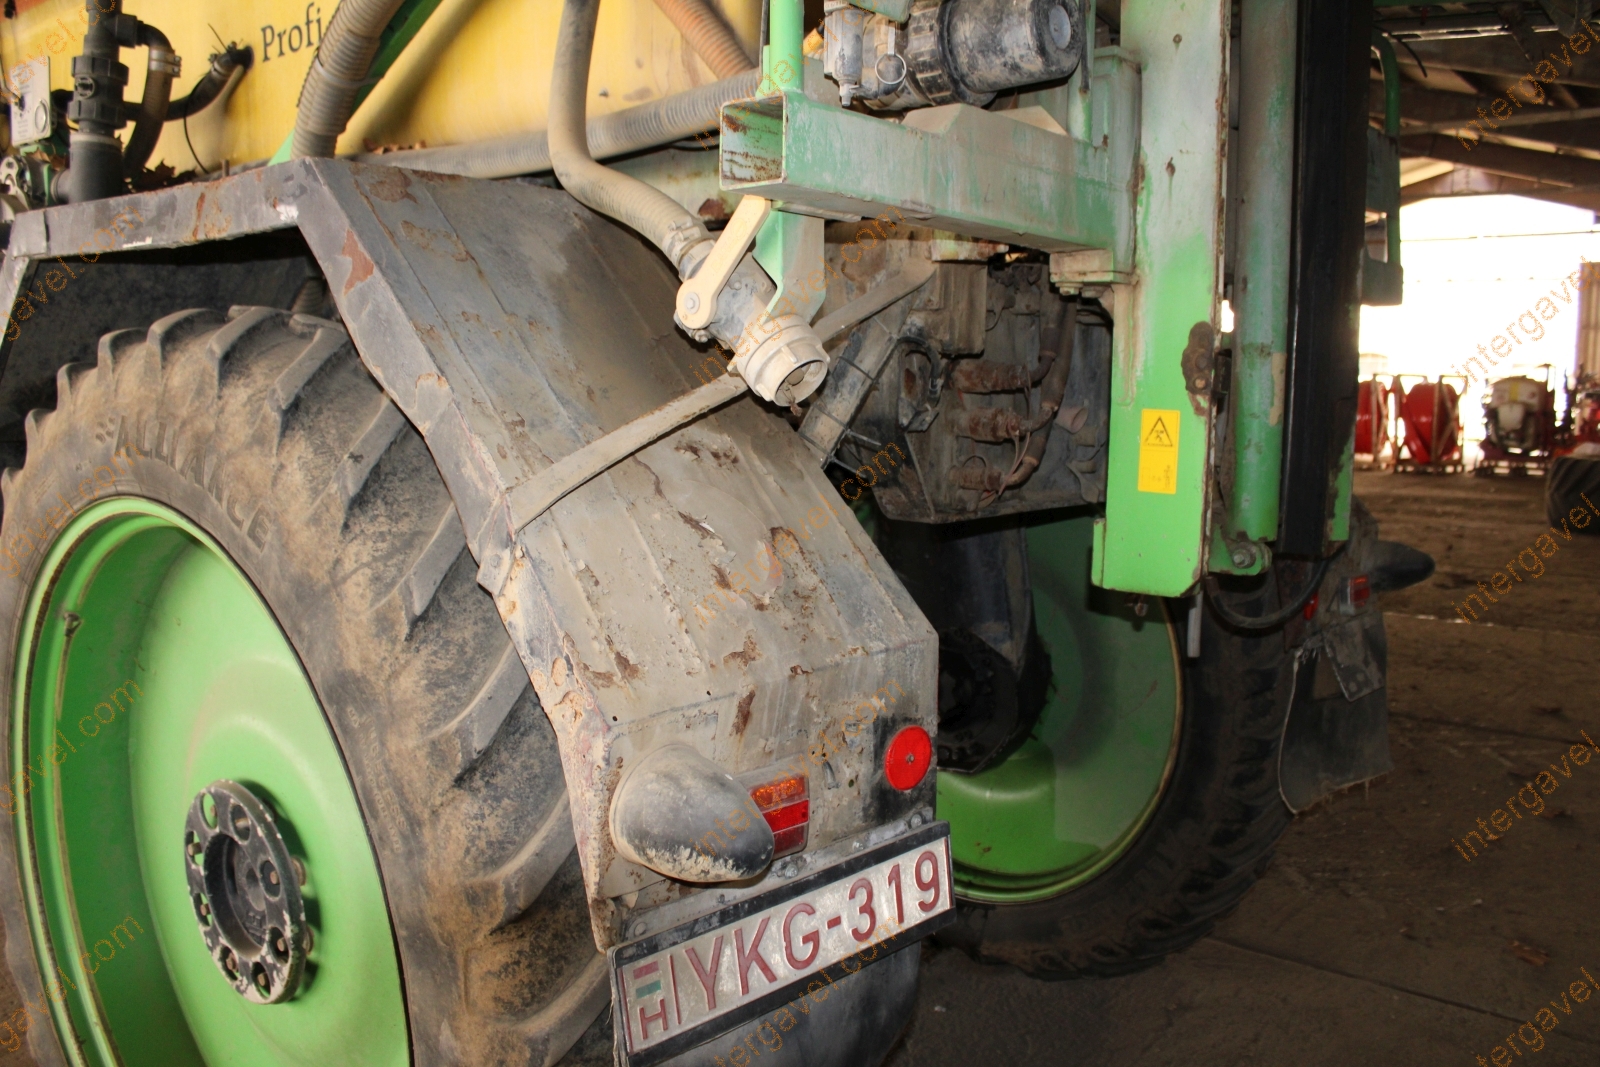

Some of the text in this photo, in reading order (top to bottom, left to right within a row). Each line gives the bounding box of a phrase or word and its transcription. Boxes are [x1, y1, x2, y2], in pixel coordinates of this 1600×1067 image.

[261, 3, 321, 63] Profi
[114, 413, 272, 553] ALLIANCE
[684, 850, 941, 1011] YKG-319
[639, 998, 668, 1040] H
